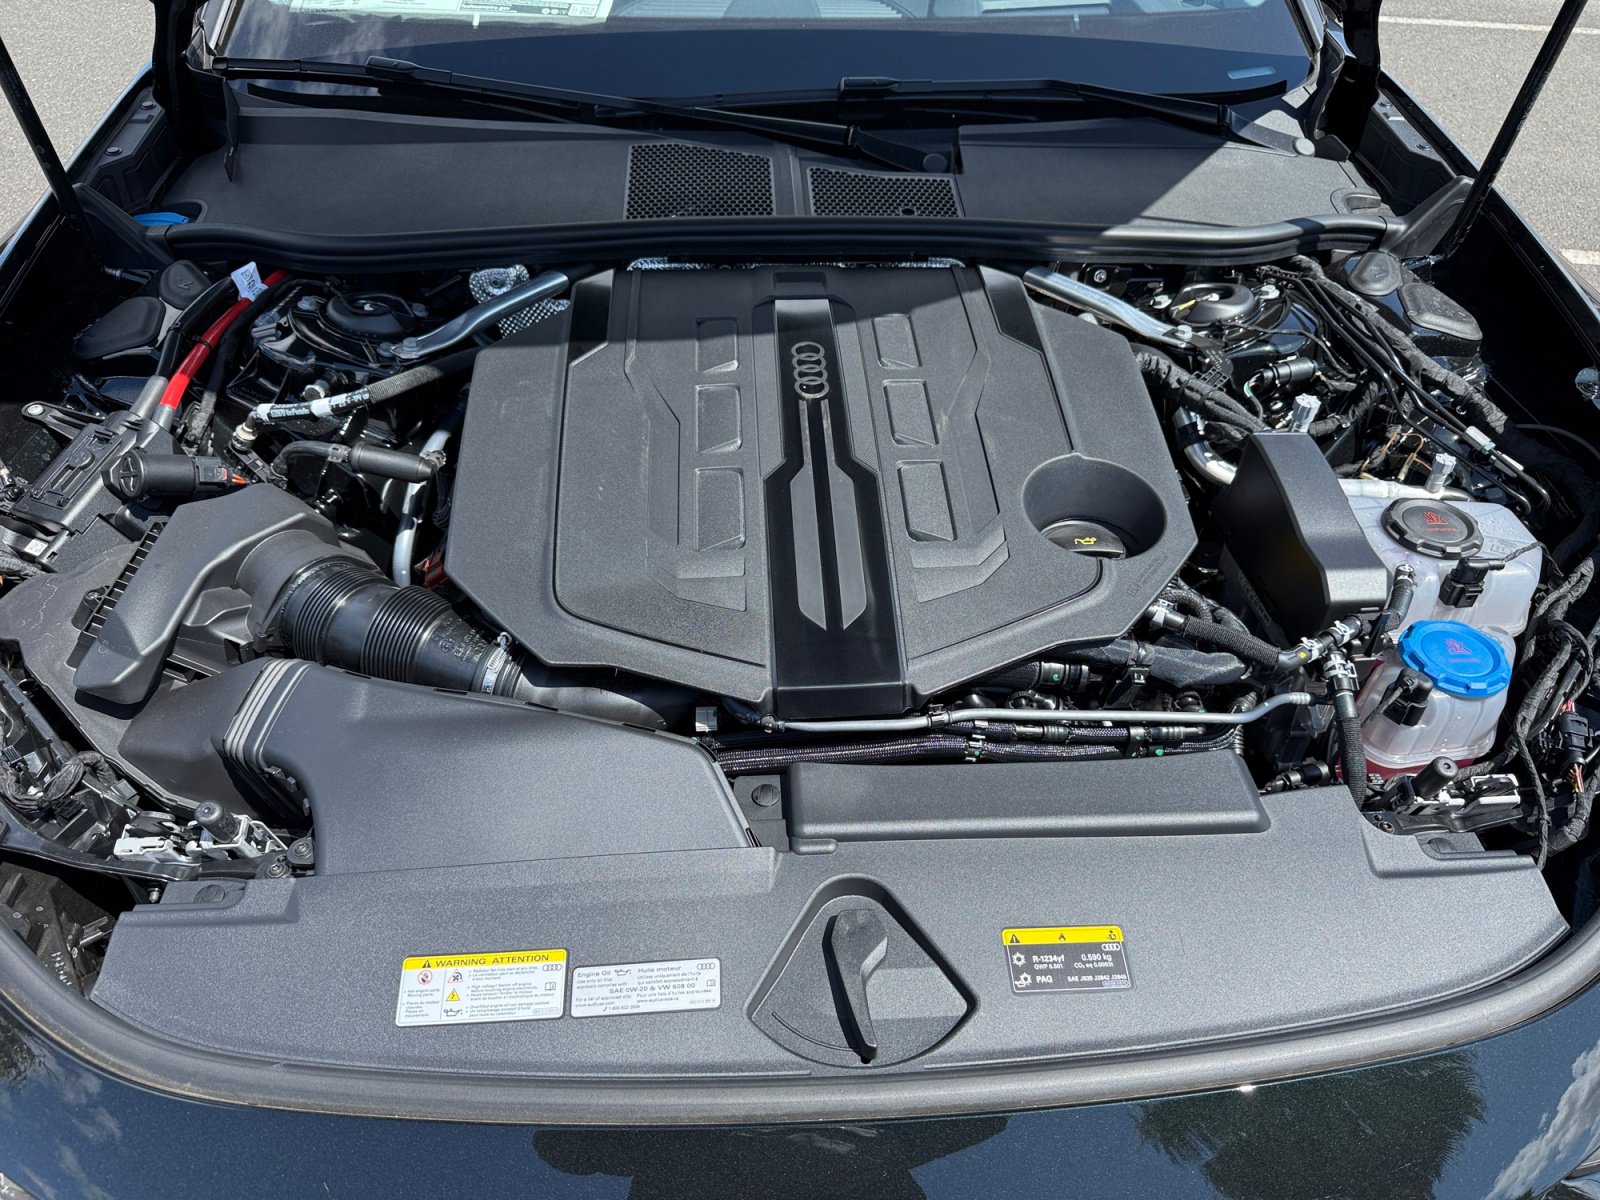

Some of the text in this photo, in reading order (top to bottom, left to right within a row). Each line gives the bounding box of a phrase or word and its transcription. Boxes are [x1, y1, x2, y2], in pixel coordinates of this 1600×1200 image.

[435, 954, 549, 967] WARNING ATTENTION
[1102, 953, 1112, 962] kg
[1036, 975, 1053, 983] PAG
